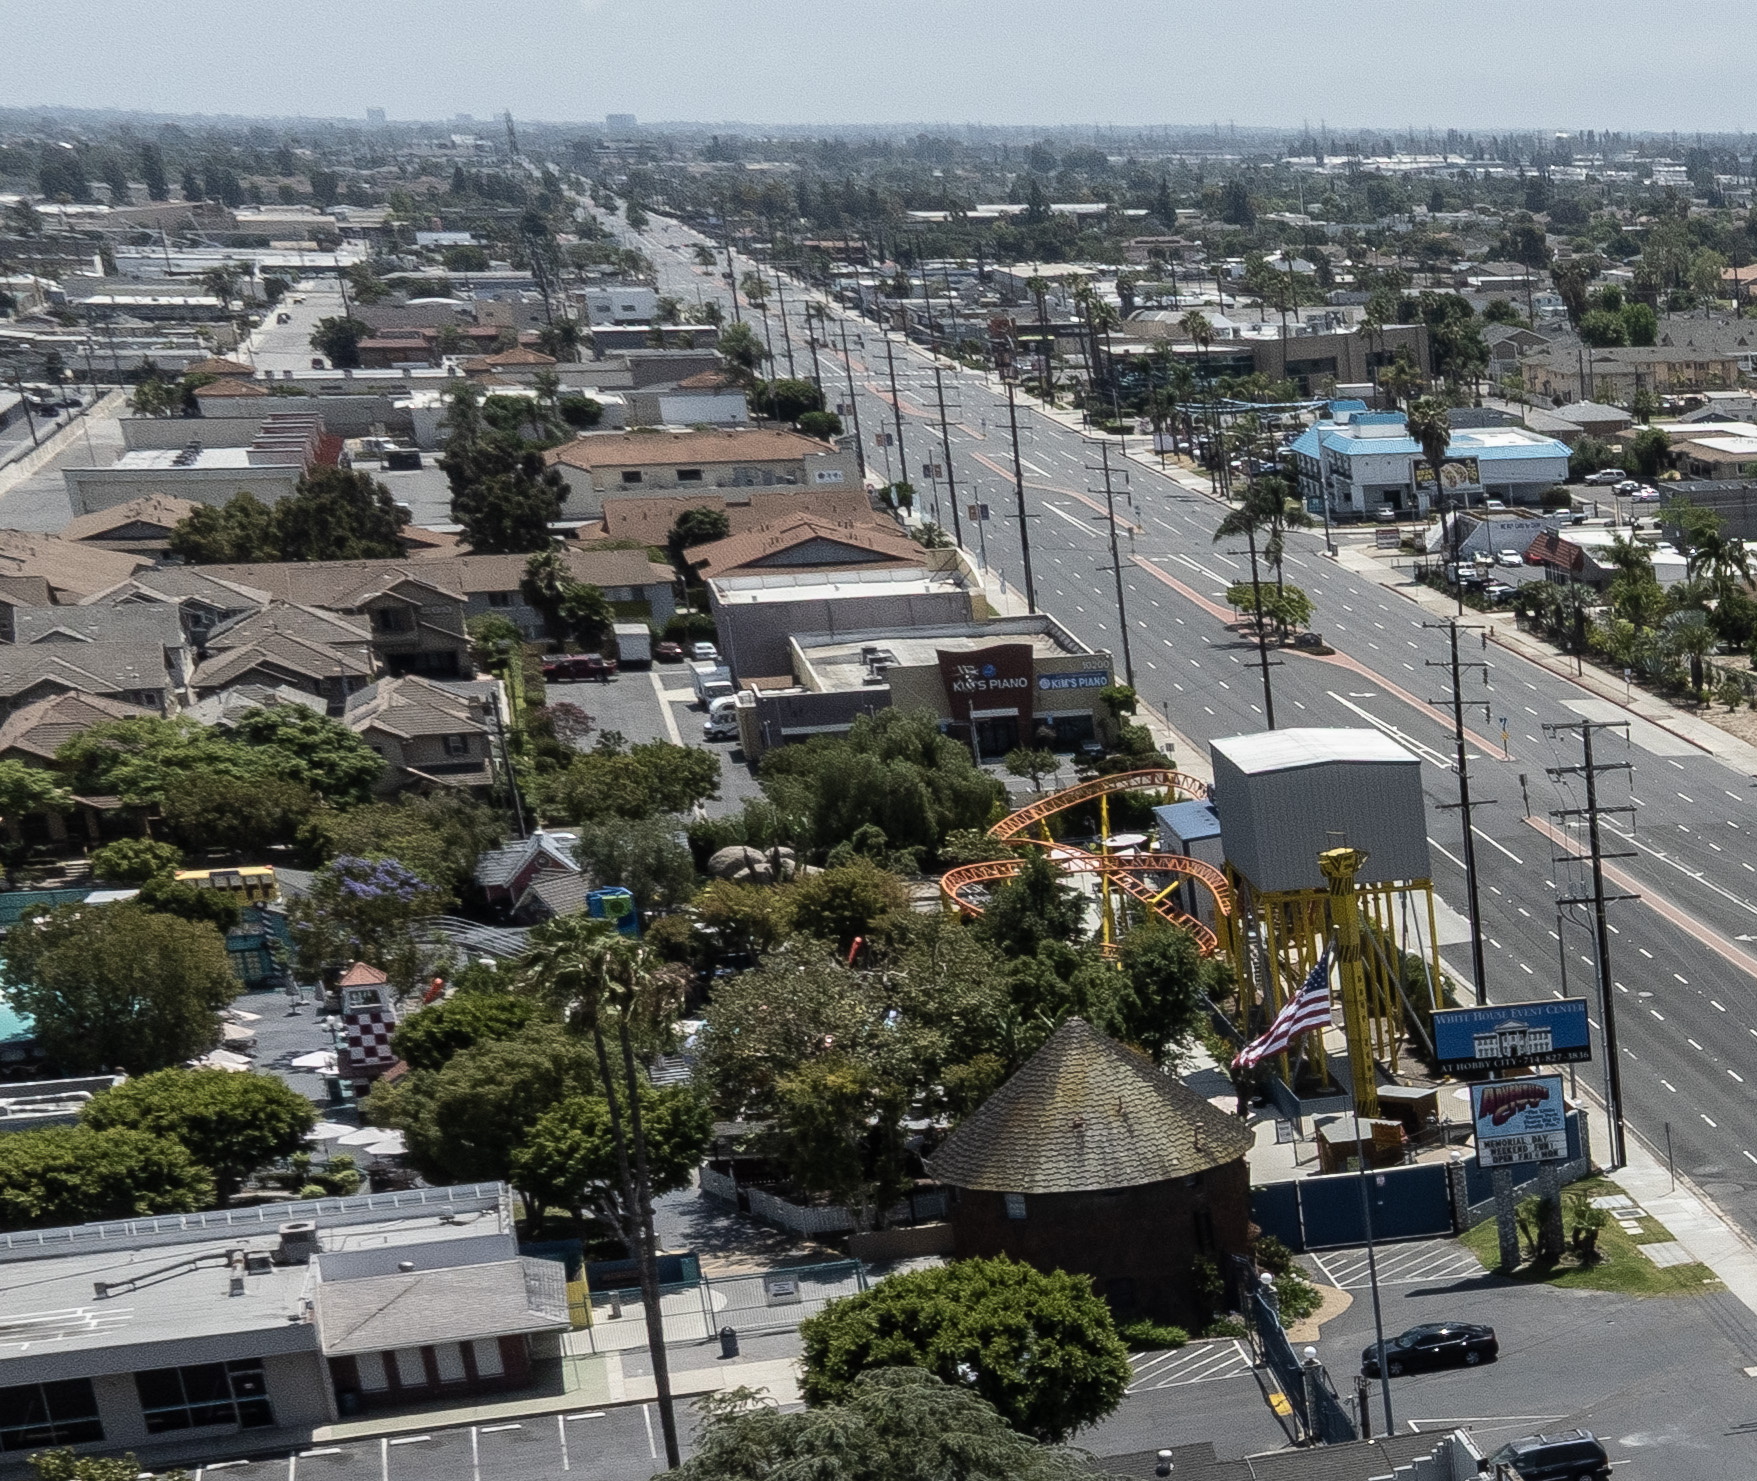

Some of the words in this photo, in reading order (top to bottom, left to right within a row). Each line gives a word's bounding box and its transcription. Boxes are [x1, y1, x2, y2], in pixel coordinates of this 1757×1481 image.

[989, 677, 1028, 689] PIANO
[1051, 679, 1077, 689] KIM'S
[1079, 676, 1108, 687] PIANO
[1434, 1013, 1470, 1025] WHITE
[1473, 1010, 1507, 1022] HOUSE
[1511, 1006, 1542, 1018] EVENT
[1545, 1002, 1585, 1015] CENTER
[1440, 1064, 1453, 1073] AT
[1456, 1060, 1491, 1072] HOBBY
[1493, 1058, 1518, 1068] CITY
[1484, 1138, 1527, 1149] MEMORIAL
[1531, 1135, 1549, 1143] DAY
[1490, 1145, 1529, 1155] WEEKEND
[1492, 1154, 1514, 1164] OPEN
